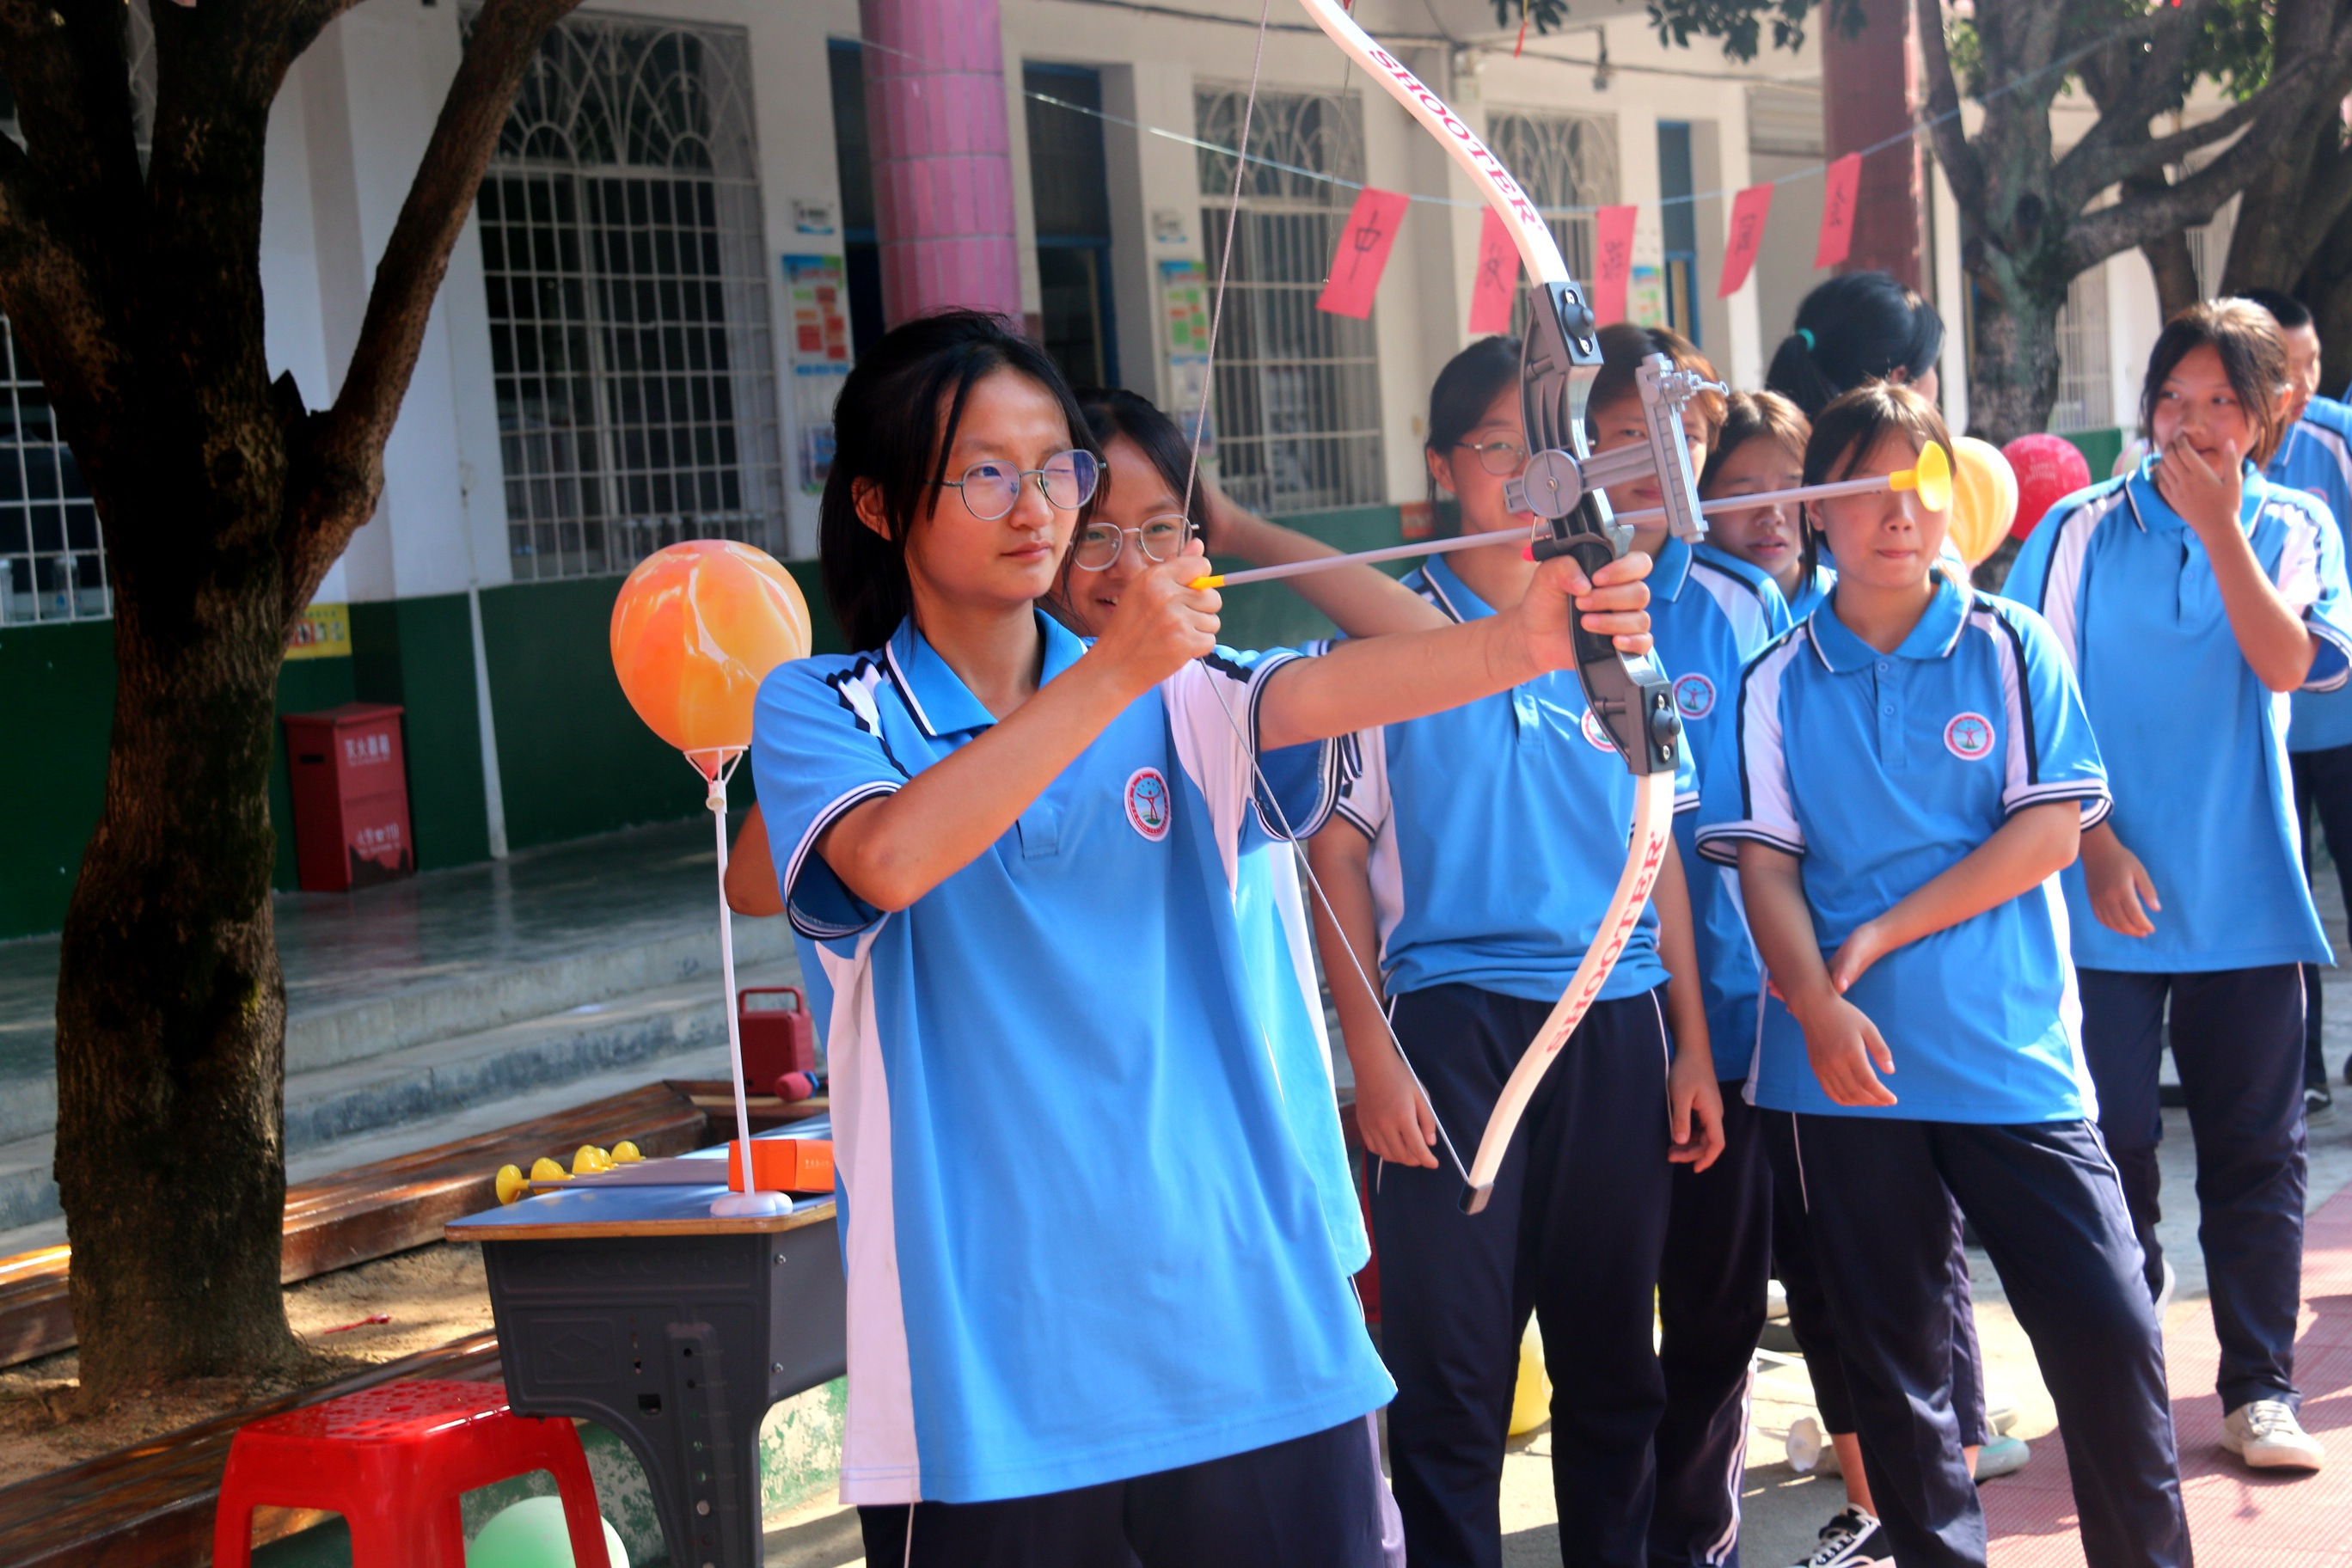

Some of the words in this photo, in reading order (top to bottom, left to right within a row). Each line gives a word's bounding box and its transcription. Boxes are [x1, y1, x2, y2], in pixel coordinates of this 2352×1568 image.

[1369, 49, 1537, 226] SHOOTER
[1349, 210, 1382, 283] 中
[1547, 835, 1665, 1053] SHOOTER
